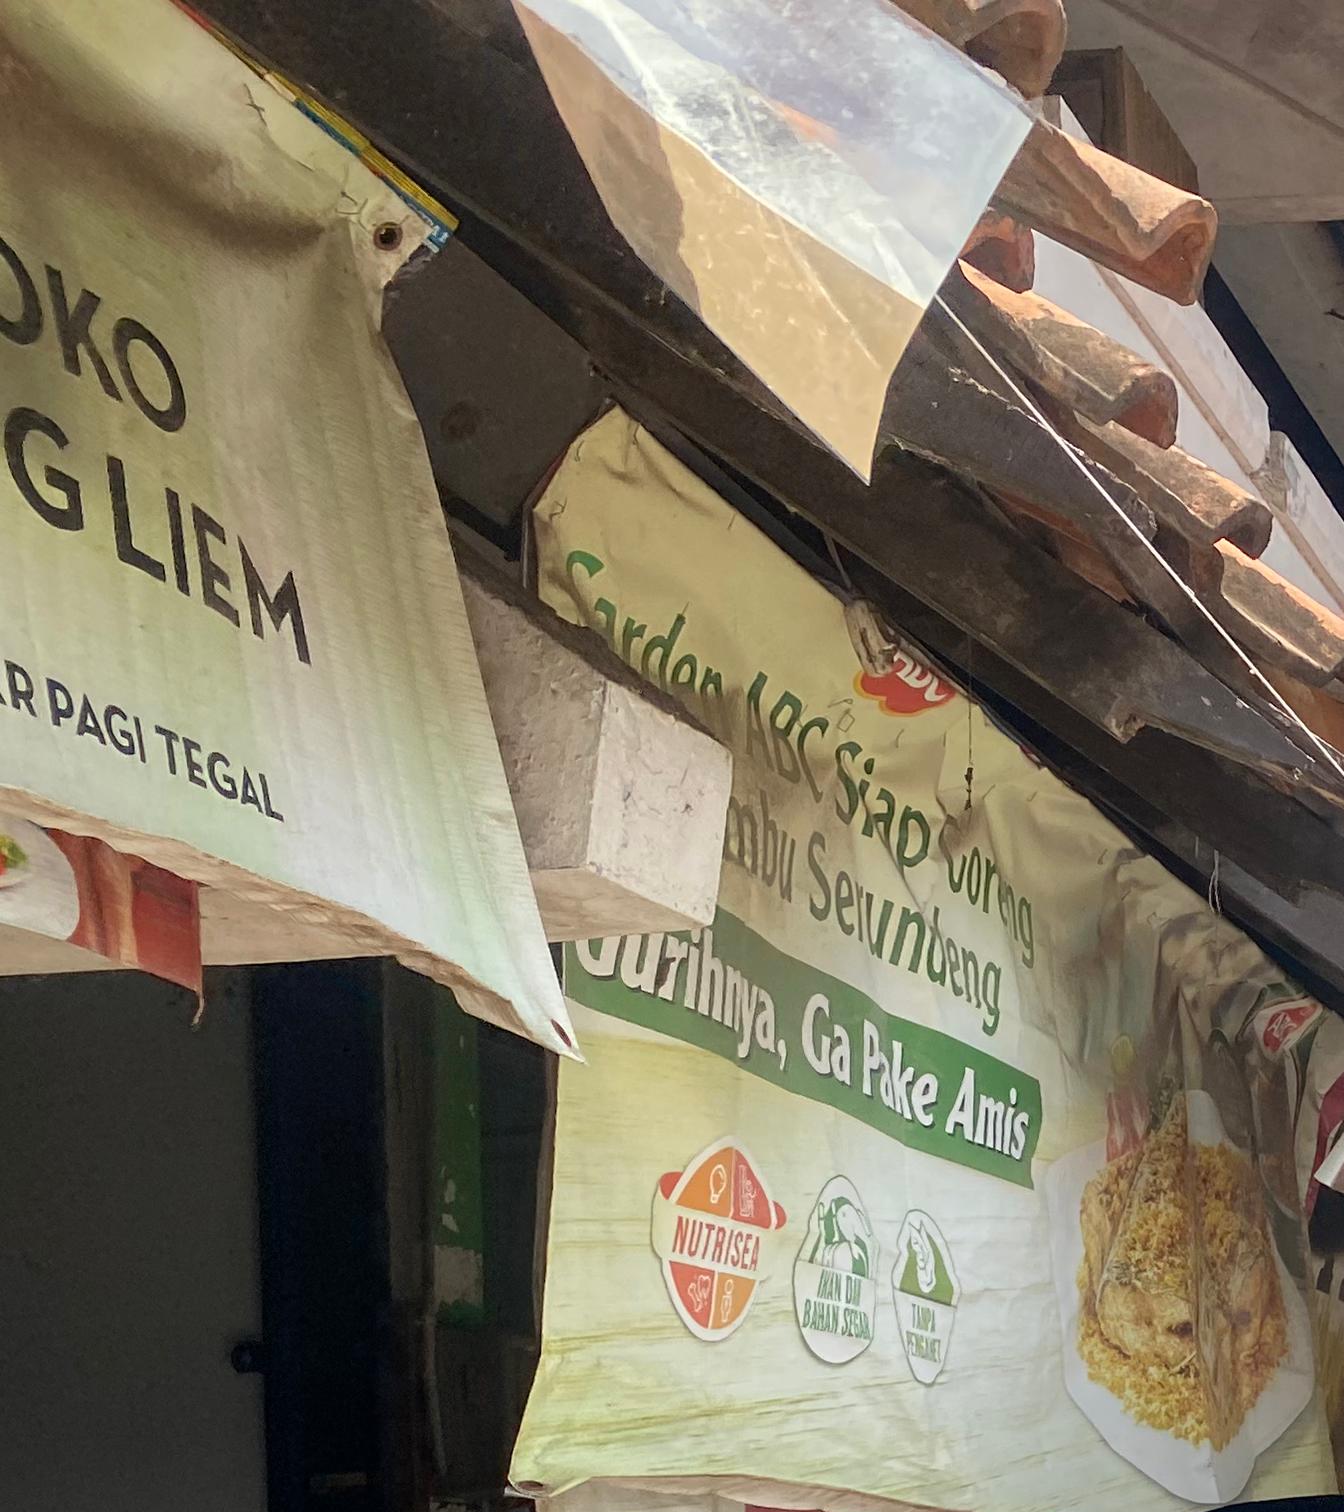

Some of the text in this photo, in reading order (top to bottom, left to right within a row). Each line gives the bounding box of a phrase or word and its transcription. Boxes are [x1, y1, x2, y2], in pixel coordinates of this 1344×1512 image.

[46, 676, 147, 765] PAGI
[154, 723, 285, 823] TEGAL
[747, 670, 829, 804] ABC
[800, 993, 852, 1087] Ga
[862, 1018, 939, 1127] Pake
[944, 1066, 1030, 1161] Amis
[672, 1215, 761, 1273] NUTRISEA
[802, 1298, 840, 1336] BAHAN
